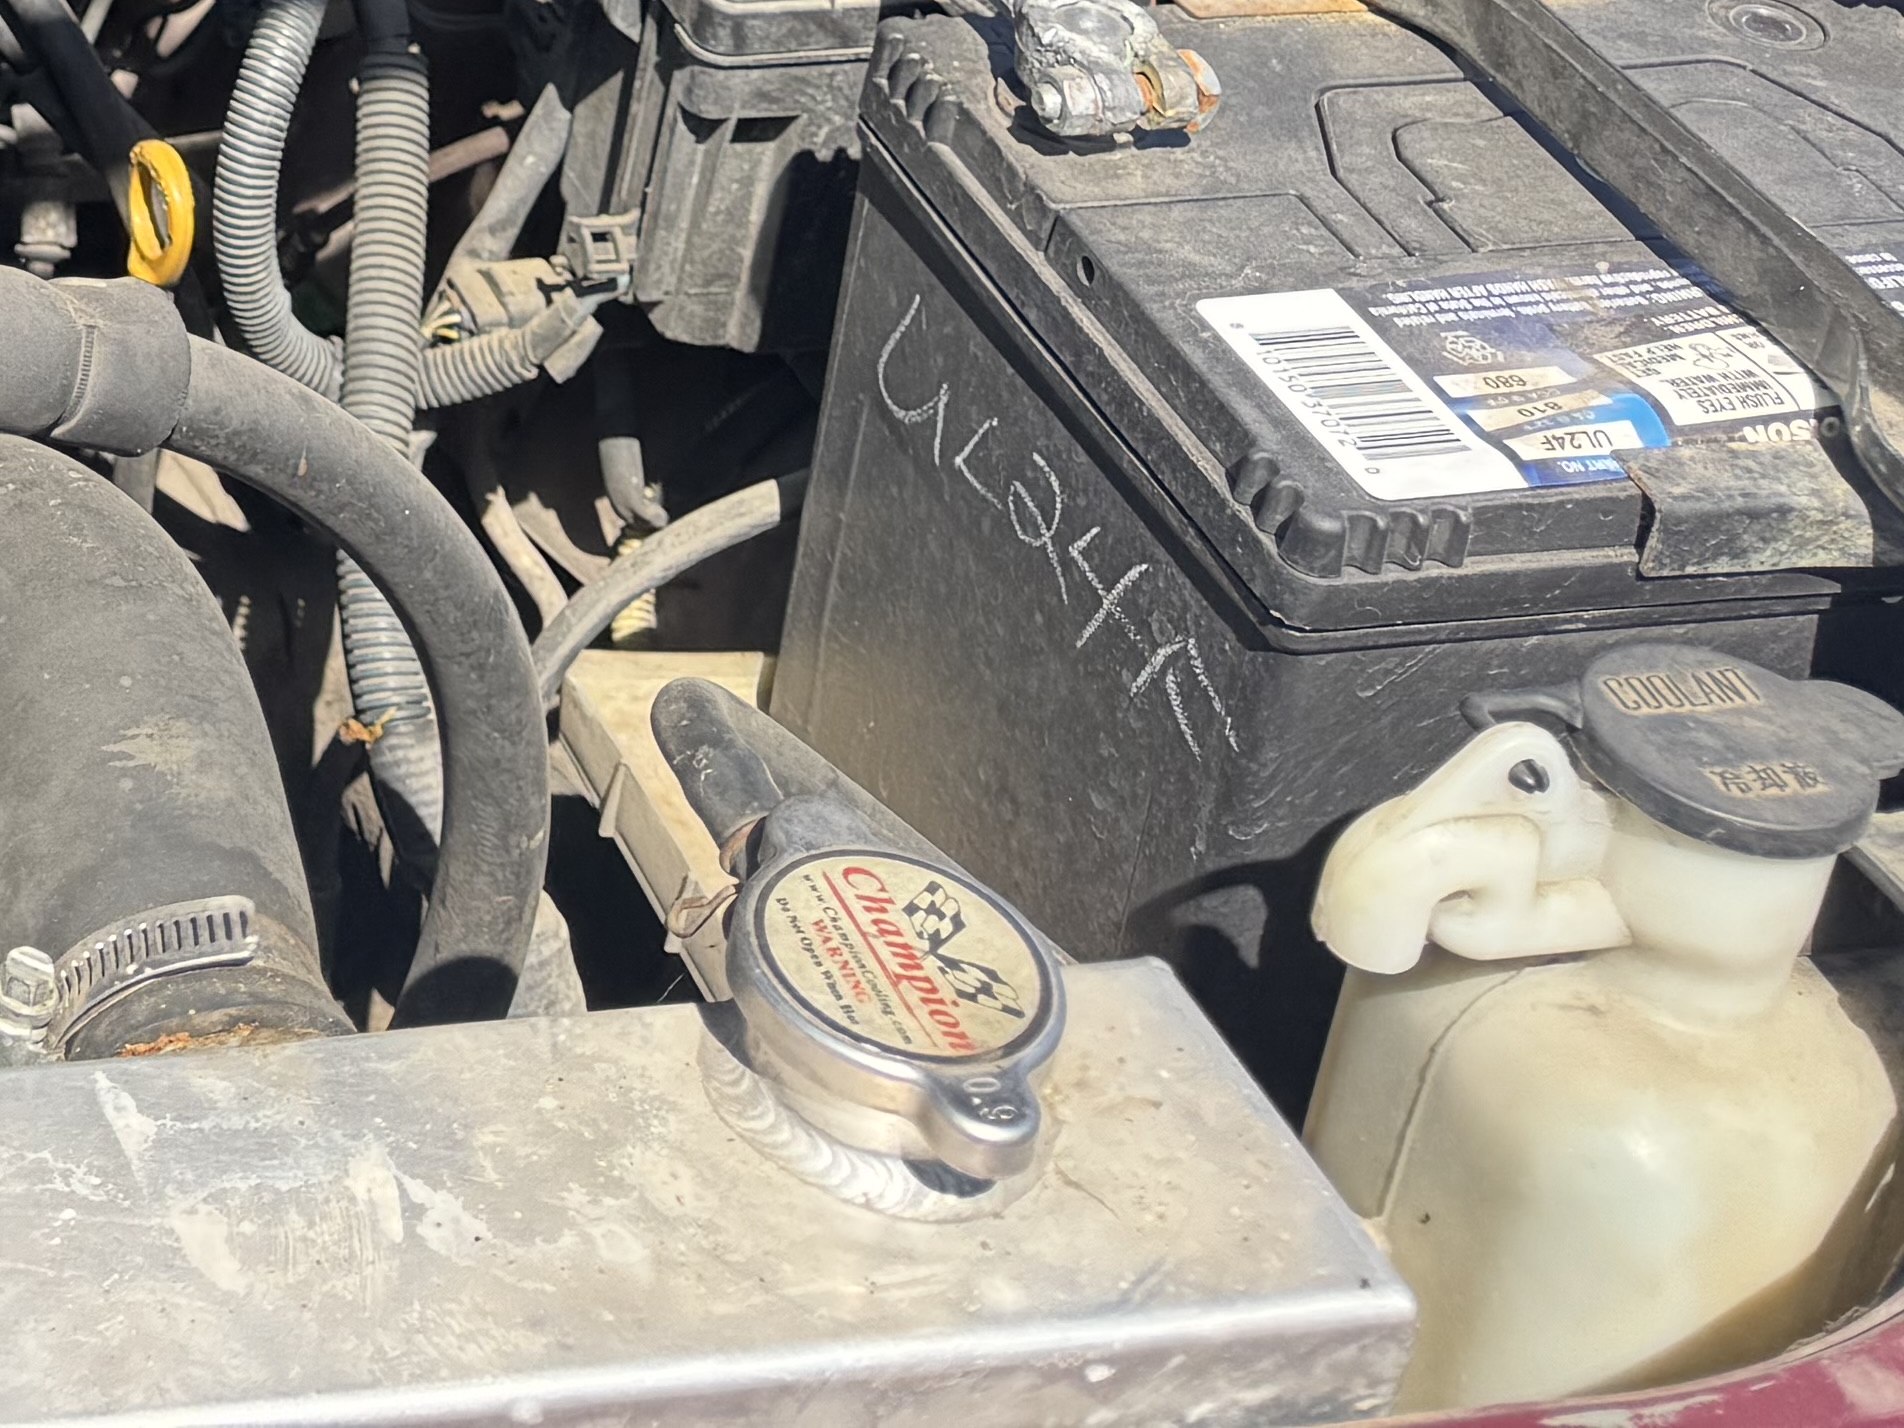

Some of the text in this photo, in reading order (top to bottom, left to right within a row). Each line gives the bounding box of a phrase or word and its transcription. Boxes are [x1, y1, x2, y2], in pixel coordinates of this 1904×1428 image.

[1483, 374, 1528, 389] 680
[1719, 368, 1760, 383] WITH
[1672, 379, 1774, 402] IMMEDIATELY
[1517, 401, 1563, 418] 810
[1696, 391, 1785, 415] FLUSH EYES
[1540, 429, 1614, 451] UL24F
[1557, 459, 1586, 474] NO.
[1602, 666, 1762, 712] COOLANT
[775, 897, 860, 1025] Do Not Open When Hot
[811, 918, 872, 1004] WARNING
[840, 865, 977, 1054] Champion
